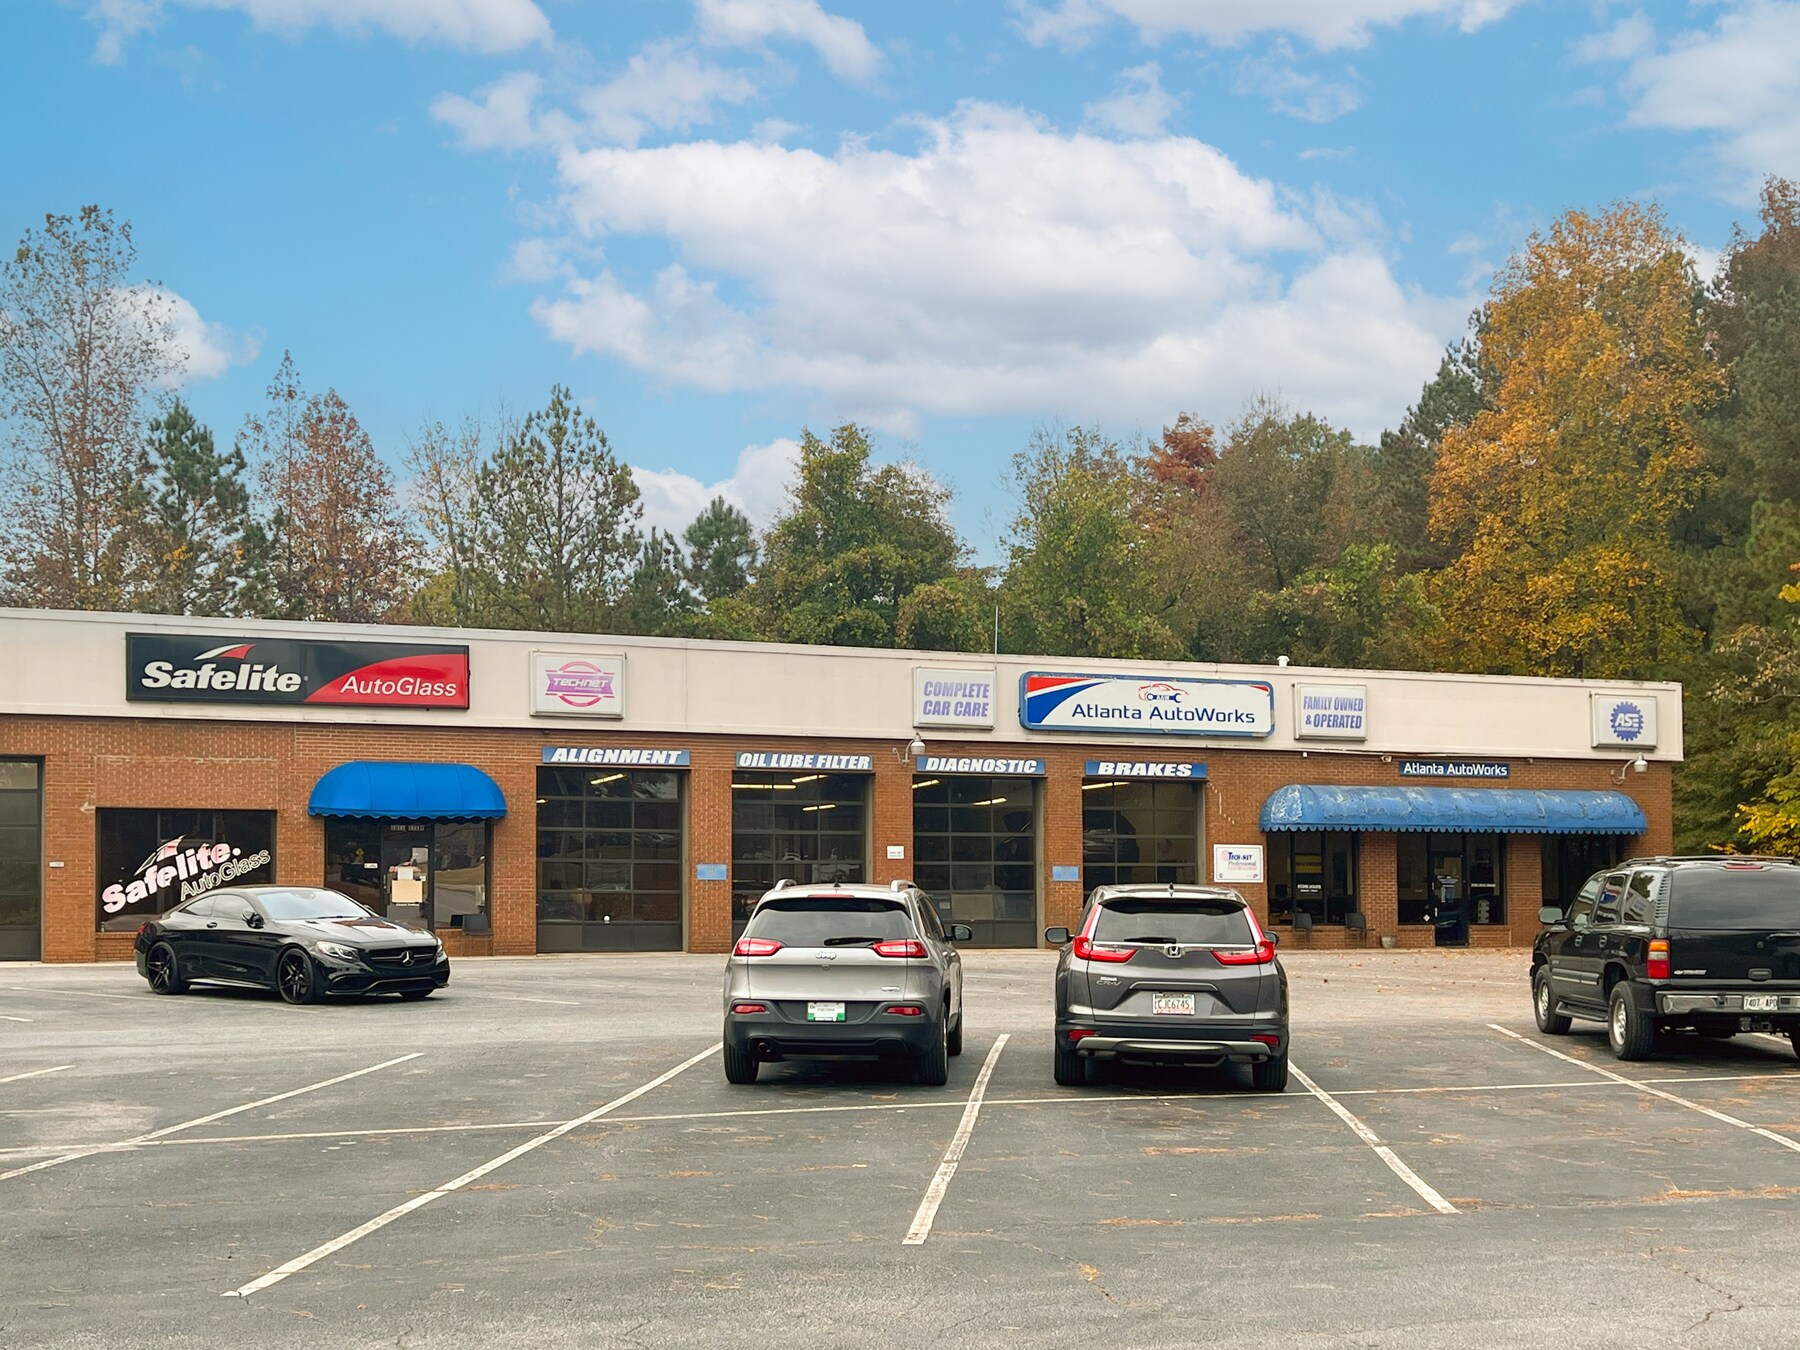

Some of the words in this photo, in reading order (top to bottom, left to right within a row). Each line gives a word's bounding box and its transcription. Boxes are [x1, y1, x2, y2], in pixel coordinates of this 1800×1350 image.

[142, 661, 301, 692] Safelite
[340, 675, 457, 697] AutoGlass
[923, 681, 990, 698] COMPLETE
[923, 700, 951, 716] CAR
[953, 701, 989, 717] CARE
[1303, 696, 1332, 710] FAMILY
[1333, 697, 1363, 711] OWNED
[1071, 703, 1142, 719] Atlanta
[1149, 706, 1255, 723] AutoWorks
[1614, 713, 1639, 727] ASE
[1305, 714, 1312, 725] &
[1313, 714, 1362, 729] OPERATED
[551, 748, 682, 765] ALIGNMENT
[739, 753, 766, 767] OIL
[770, 754, 814, 768] LUBE
[816, 755, 870, 769] FILTER
[925, 757, 1037, 773] DIAGNOSTIC
[1098, 762, 1192, 777] BRAKES
[1403, 762, 1444, 774] Atlanta
[1446, 763, 1508, 775] AutoWorks
[180, 849, 271, 902] AutoGlass
[1157, 1000, 1190, 1009] CJC6745
